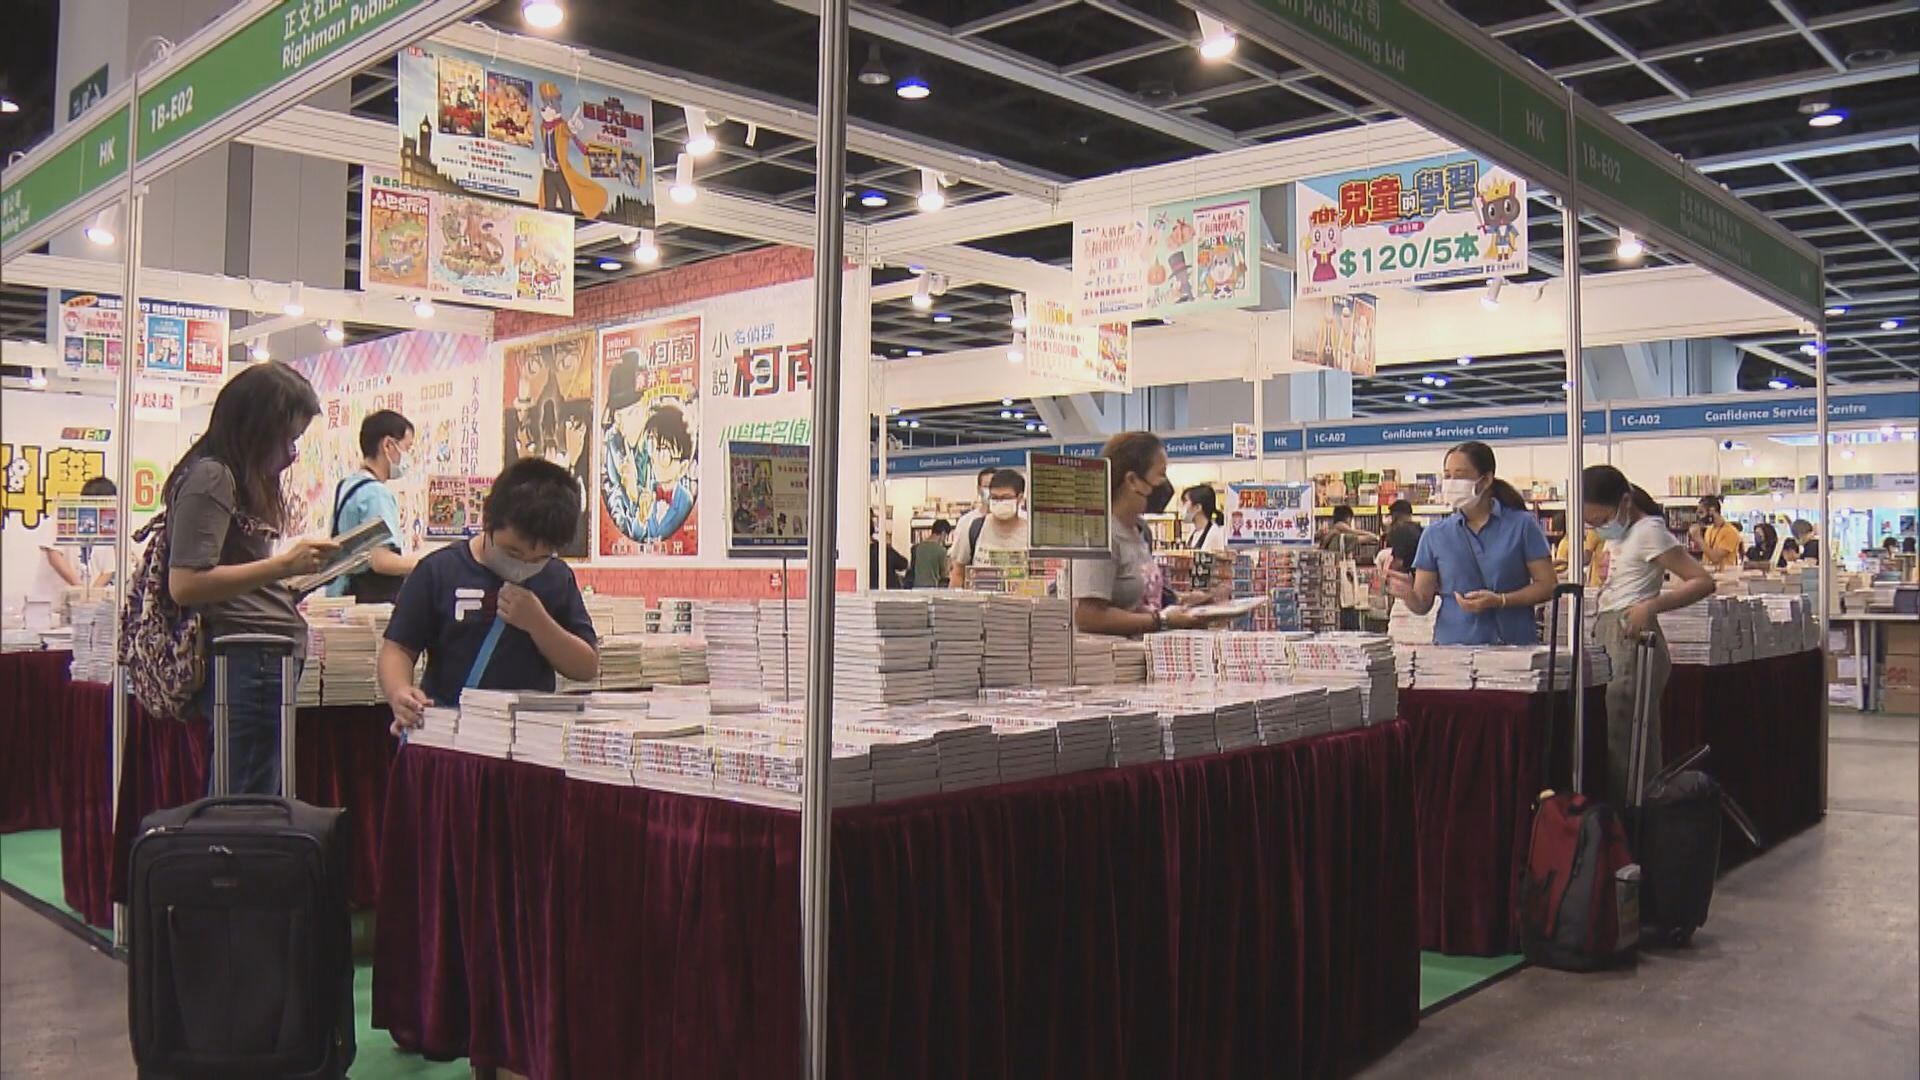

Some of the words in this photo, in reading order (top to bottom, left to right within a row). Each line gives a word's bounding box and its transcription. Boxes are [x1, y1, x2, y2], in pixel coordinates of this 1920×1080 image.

[282, 18, 346, 69] Rightman
[1385, 40, 1405, 72] Ltd
[151, 86, 193, 133] 1B-E02
[1525, 109, 1545, 142] HK
[99, 136, 116, 166] HK
[1583, 141, 1620, 184] 1B-E02
[1338, 160, 1480, 230] 兒童的學習
[1338, 231, 1480, 278] $120/5本
[1622, 415, 1661, 426] 1C-A02
[1705, 408, 1769, 422] Confidence
[1773, 405, 1816, 418] Service
[1827, 403, 1867, 415] Centre
[1166, 443, 1197, 453] Services
[1200, 440, 1225, 451] Centre
[1274, 437, 1287, 446] HK
[1315, 432, 1345, 443] 1C-A02
[1382, 428, 1433, 440] Confidence
[1435, 426, 1473, 437] Services
[1477, 424, 1509, 435] Centre
[919, 459, 952, 468] Confidence
[953, 457, 978, 465] Services
[979, 455, 1001, 464] Centre
[455, 588, 485, 621] F
